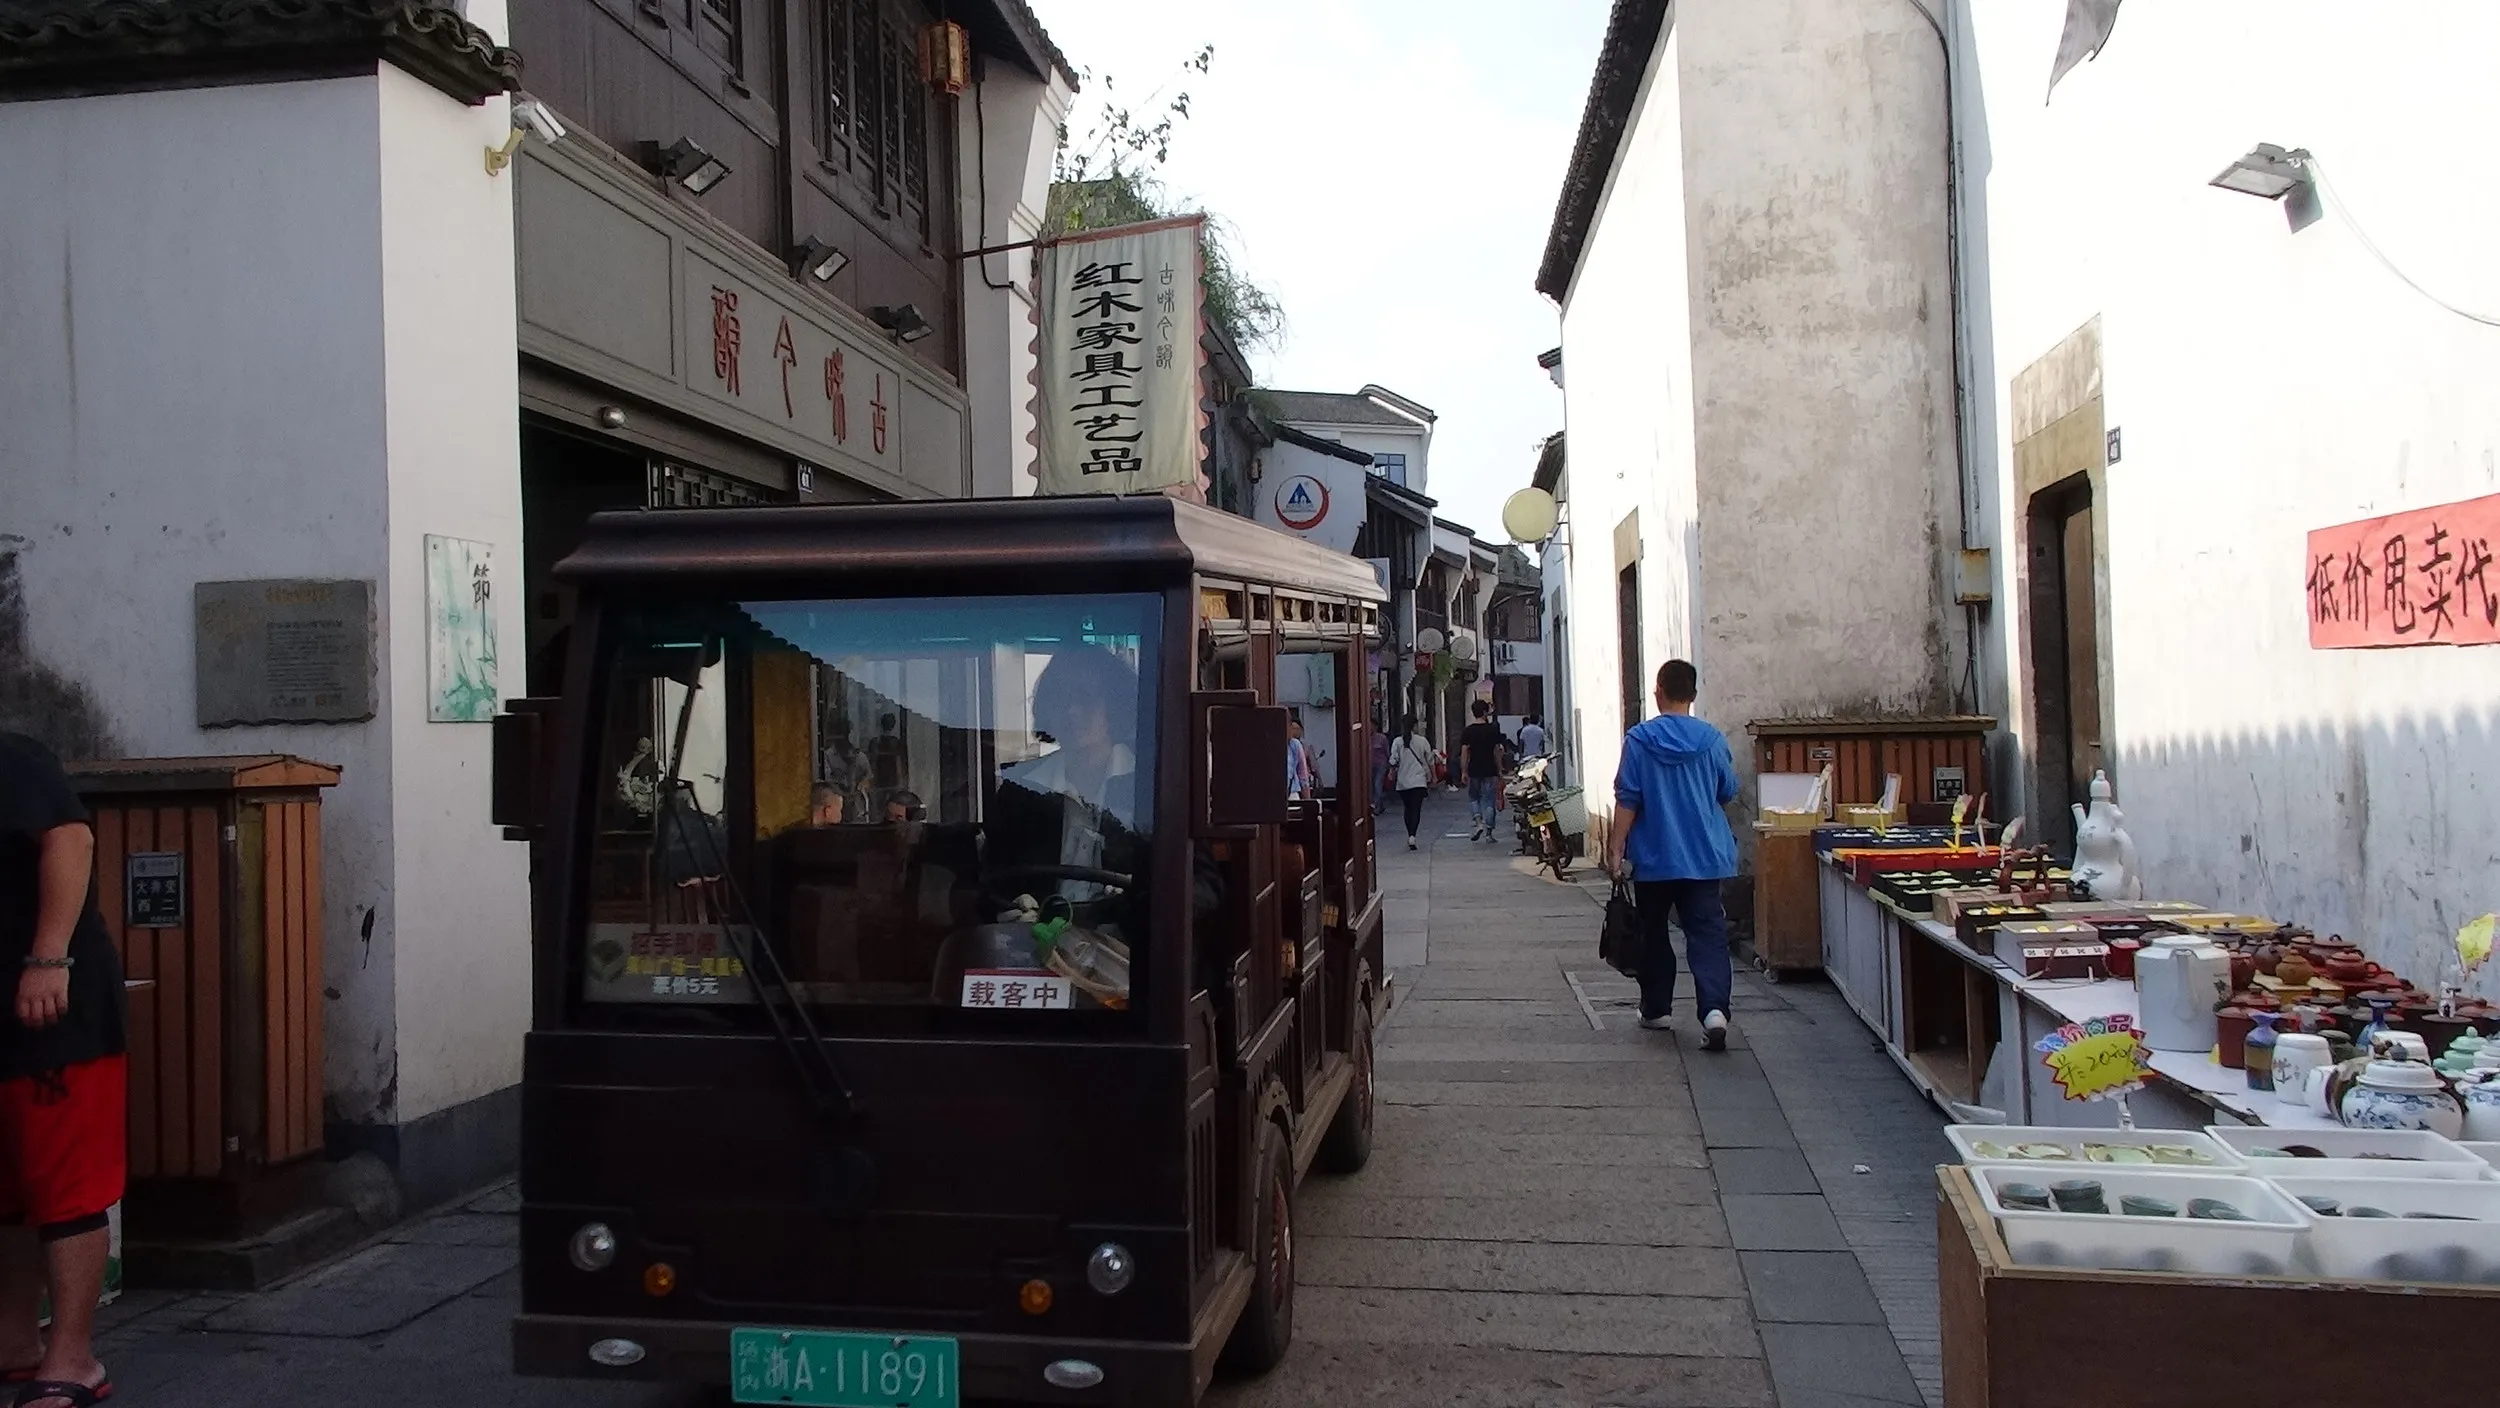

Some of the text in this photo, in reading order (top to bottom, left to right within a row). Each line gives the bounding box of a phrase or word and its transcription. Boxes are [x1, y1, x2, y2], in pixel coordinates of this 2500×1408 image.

[1070, 262, 1144, 475] 红木家具工艺品
[2306, 521, 2499, 640] 低价甩卖代
[968, 981, 1059, 1007] 载客中
